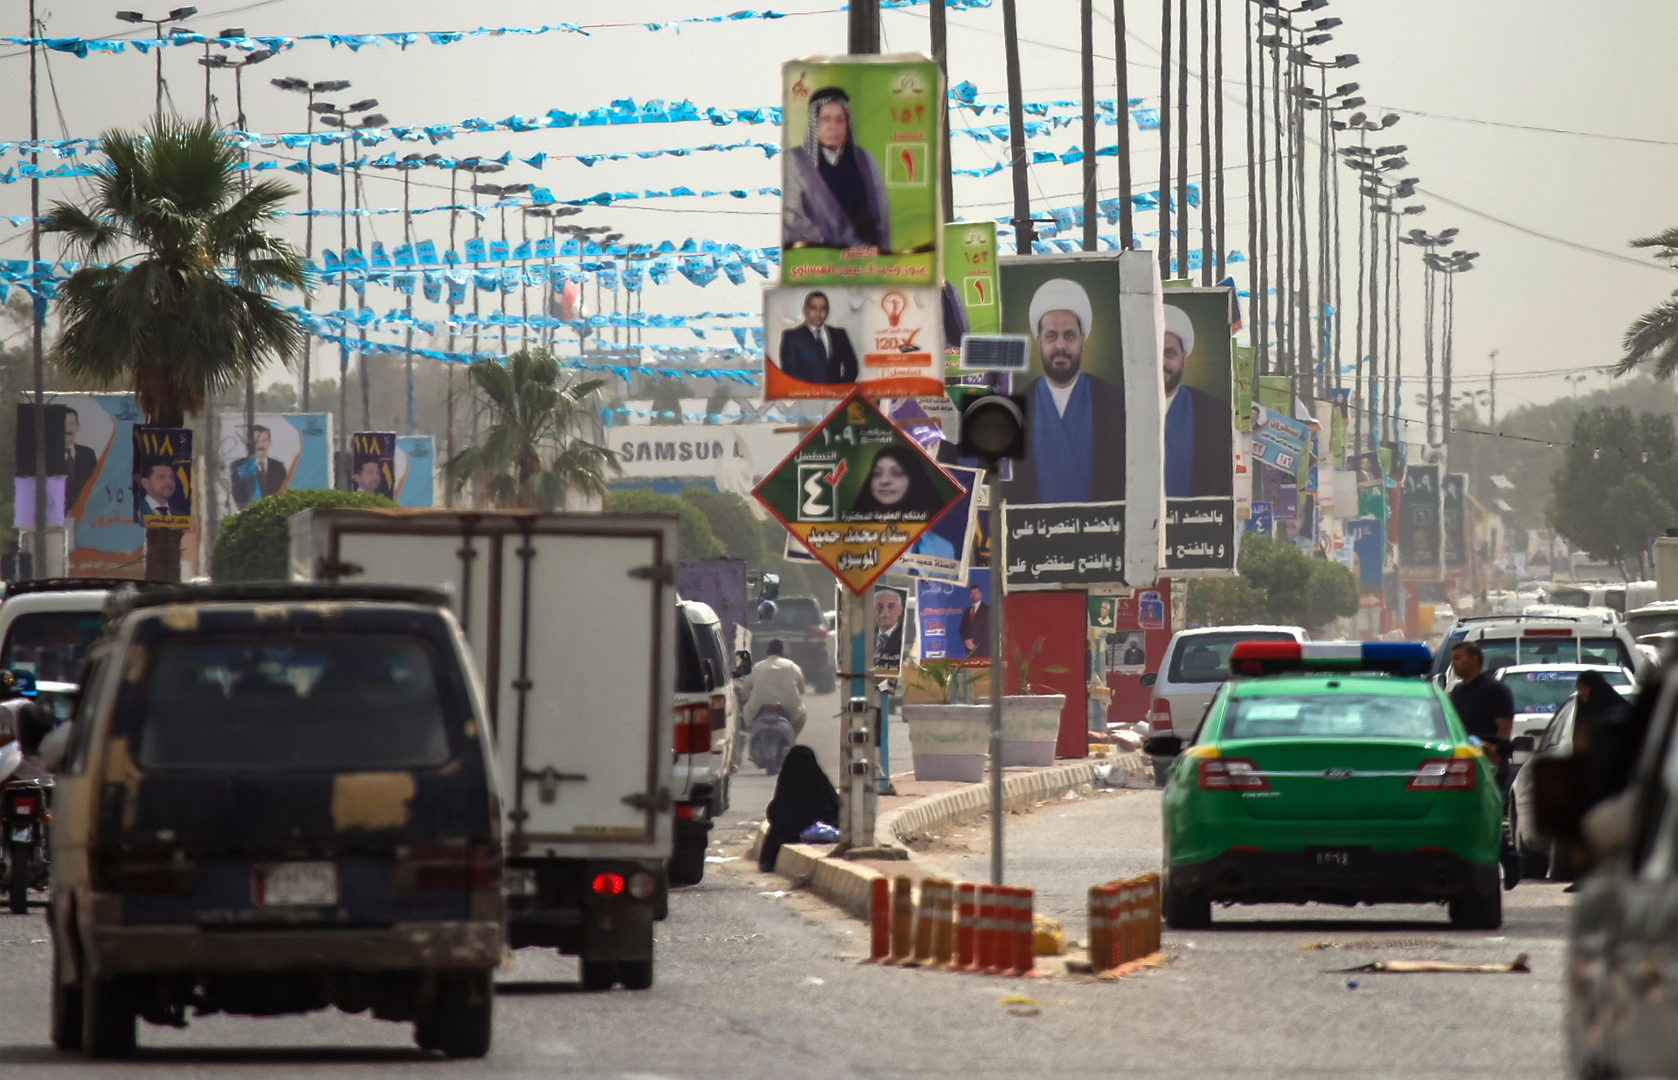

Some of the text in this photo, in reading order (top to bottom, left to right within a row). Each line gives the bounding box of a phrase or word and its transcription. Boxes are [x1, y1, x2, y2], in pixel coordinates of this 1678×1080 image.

[875, 337, 899, 350] 120
[822, 425, 857, 447] ١٠٩
[803, 469, 831, 517] ٤
[1182, 509, 1223, 524] بالحشد
[806, 526, 841, 548] حميد
[844, 525, 878, 545] محمد
[1011, 517, 1121, 540] بالحشد انتصرنا على
[836, 547, 879, 572] الموسوي
[1176, 542, 1214, 558] بالفتح
[1031, 554, 1075, 579] سنقضي
